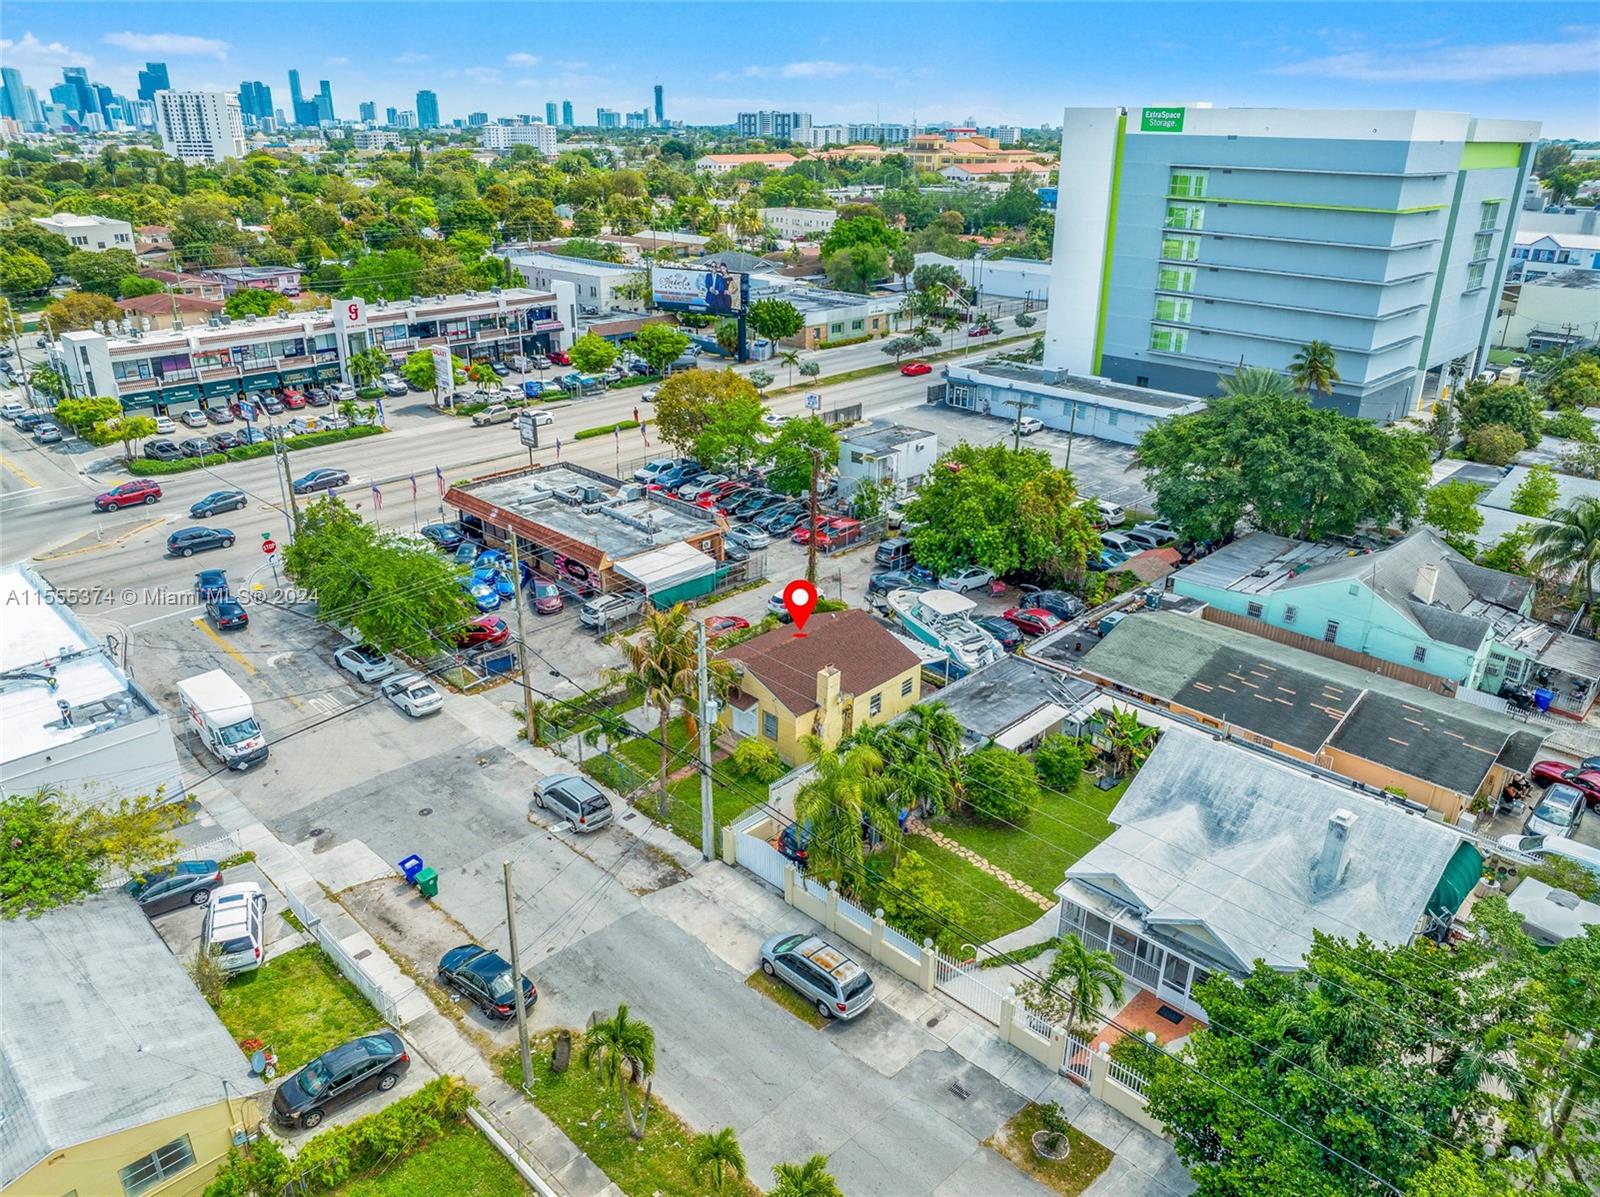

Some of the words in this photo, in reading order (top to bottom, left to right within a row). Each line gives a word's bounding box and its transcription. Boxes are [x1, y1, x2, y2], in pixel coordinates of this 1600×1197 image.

[1145, 111, 1181, 119] ExtraSpace
[263, 543, 276, 551] STOP
[234, 741, 259, 753] FedEx
